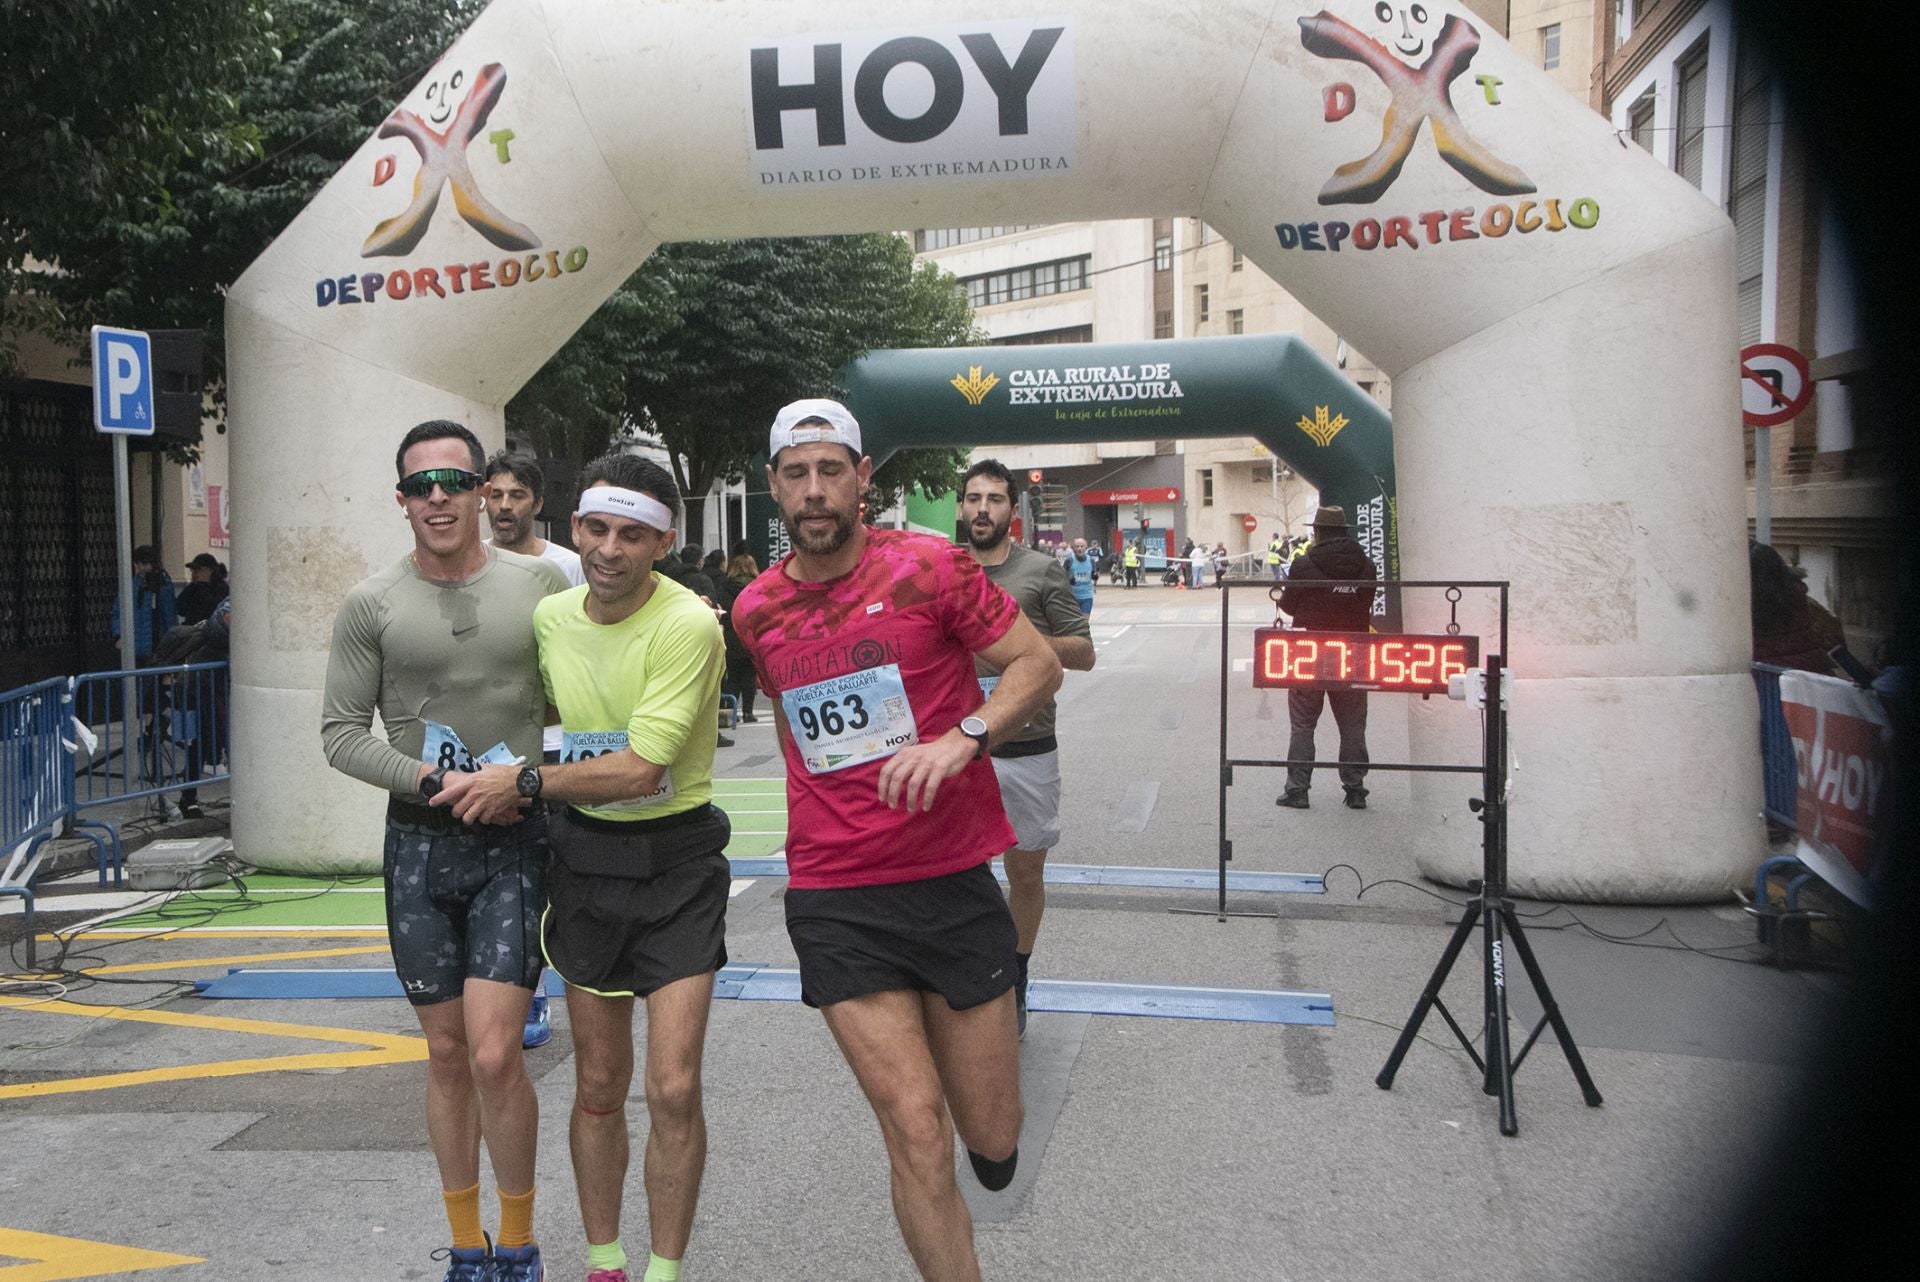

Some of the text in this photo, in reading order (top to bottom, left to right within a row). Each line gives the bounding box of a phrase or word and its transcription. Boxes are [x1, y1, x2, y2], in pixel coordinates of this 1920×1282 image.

[750, 27, 1066, 150] HOY
[760, 156, 1070, 185] DIARIO DE EXTREMADURA
[1274, 197, 1600, 252] DEPORTEOCIO
[315, 245, 589, 307] DEPORTEOCIO
[107, 341, 141, 419] P
[1009, 363, 1171, 387] CAJA RURAL DE
[1009, 381, 1184, 405] EXTREMADURA
[1070, 409, 1091, 421] caja
[1095, 407, 1107, 418] de
[1111, 406, 1182, 417] Extremadura
[768, 518, 779, 538] DE
[796, 689, 825, 702] VUELTA
[826, 687, 837, 696] AL
[838, 675, 879, 692] BALUARTE
[839, 670, 876, 684] POPULAR
[799, 694, 869, 741] 963
[886, 733, 911, 747] HOY
[1492, 941, 1504, 987] VONYX
